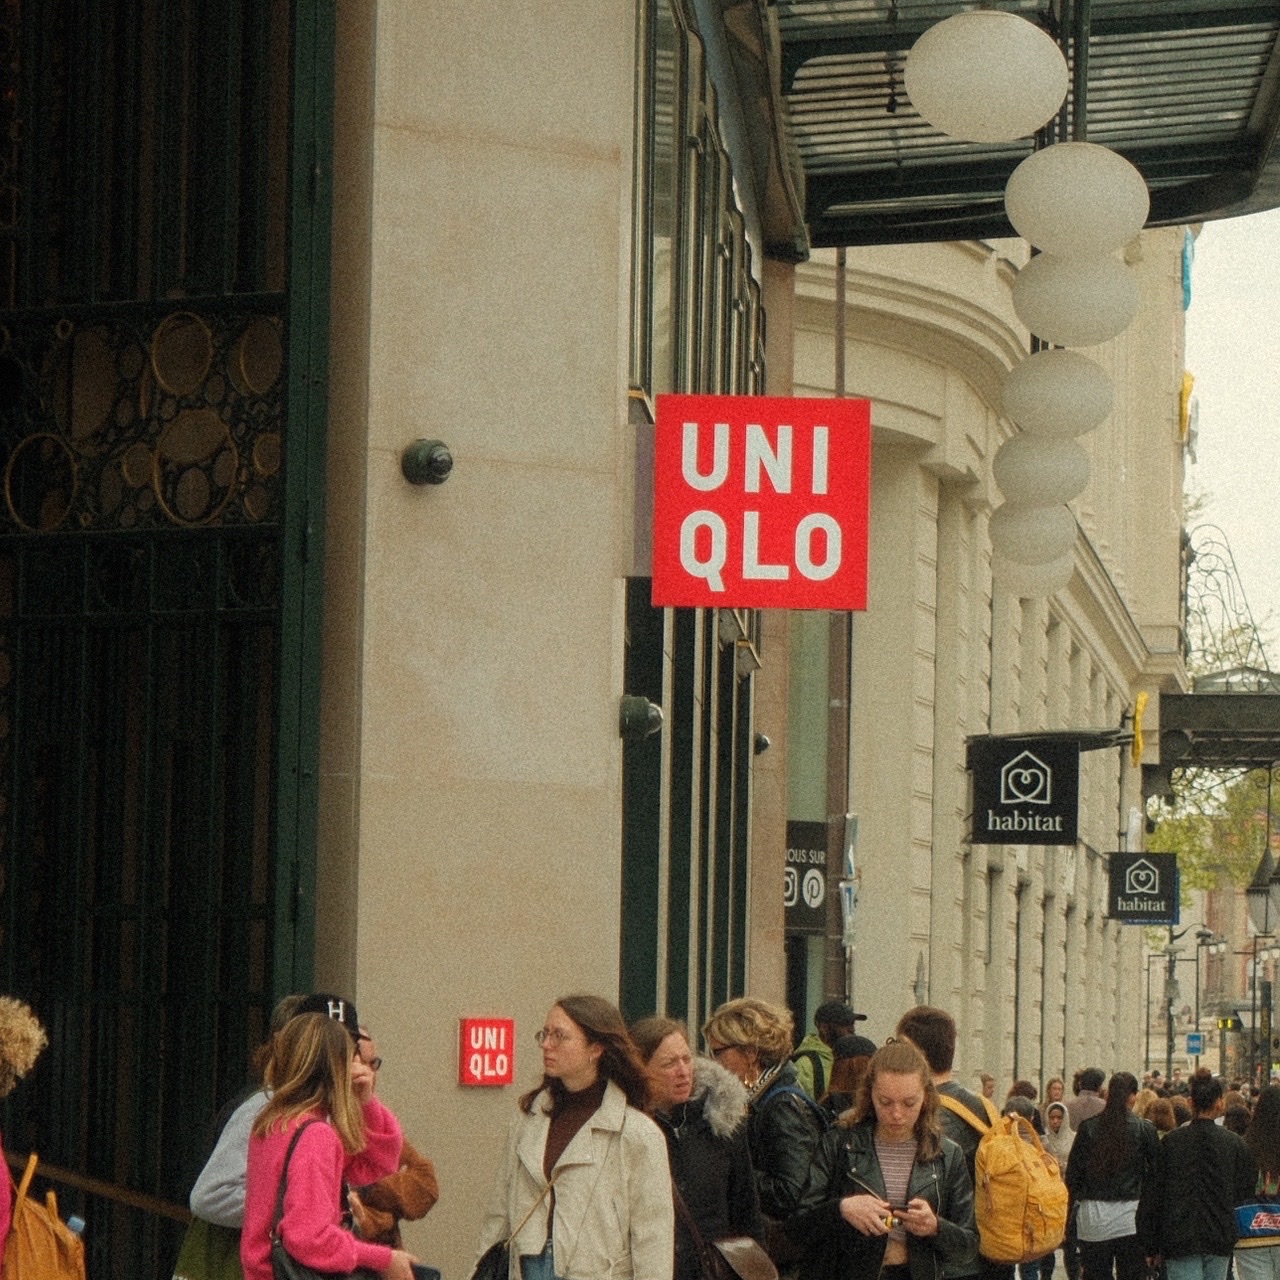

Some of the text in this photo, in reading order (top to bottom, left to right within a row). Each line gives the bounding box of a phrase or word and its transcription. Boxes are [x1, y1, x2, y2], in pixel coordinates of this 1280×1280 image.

[682, 422, 829, 495] UNI
[679, 509, 843, 592] QLO
[987, 809, 1063, 832] habitat
[785, 848, 826, 865] OUS SUR
[1117, 896, 1166, 912] habitat
[327, 1000, 344, 1022] H
[470, 1027, 505, 1050] UNI
[469, 1053, 508, 1080] QLO
